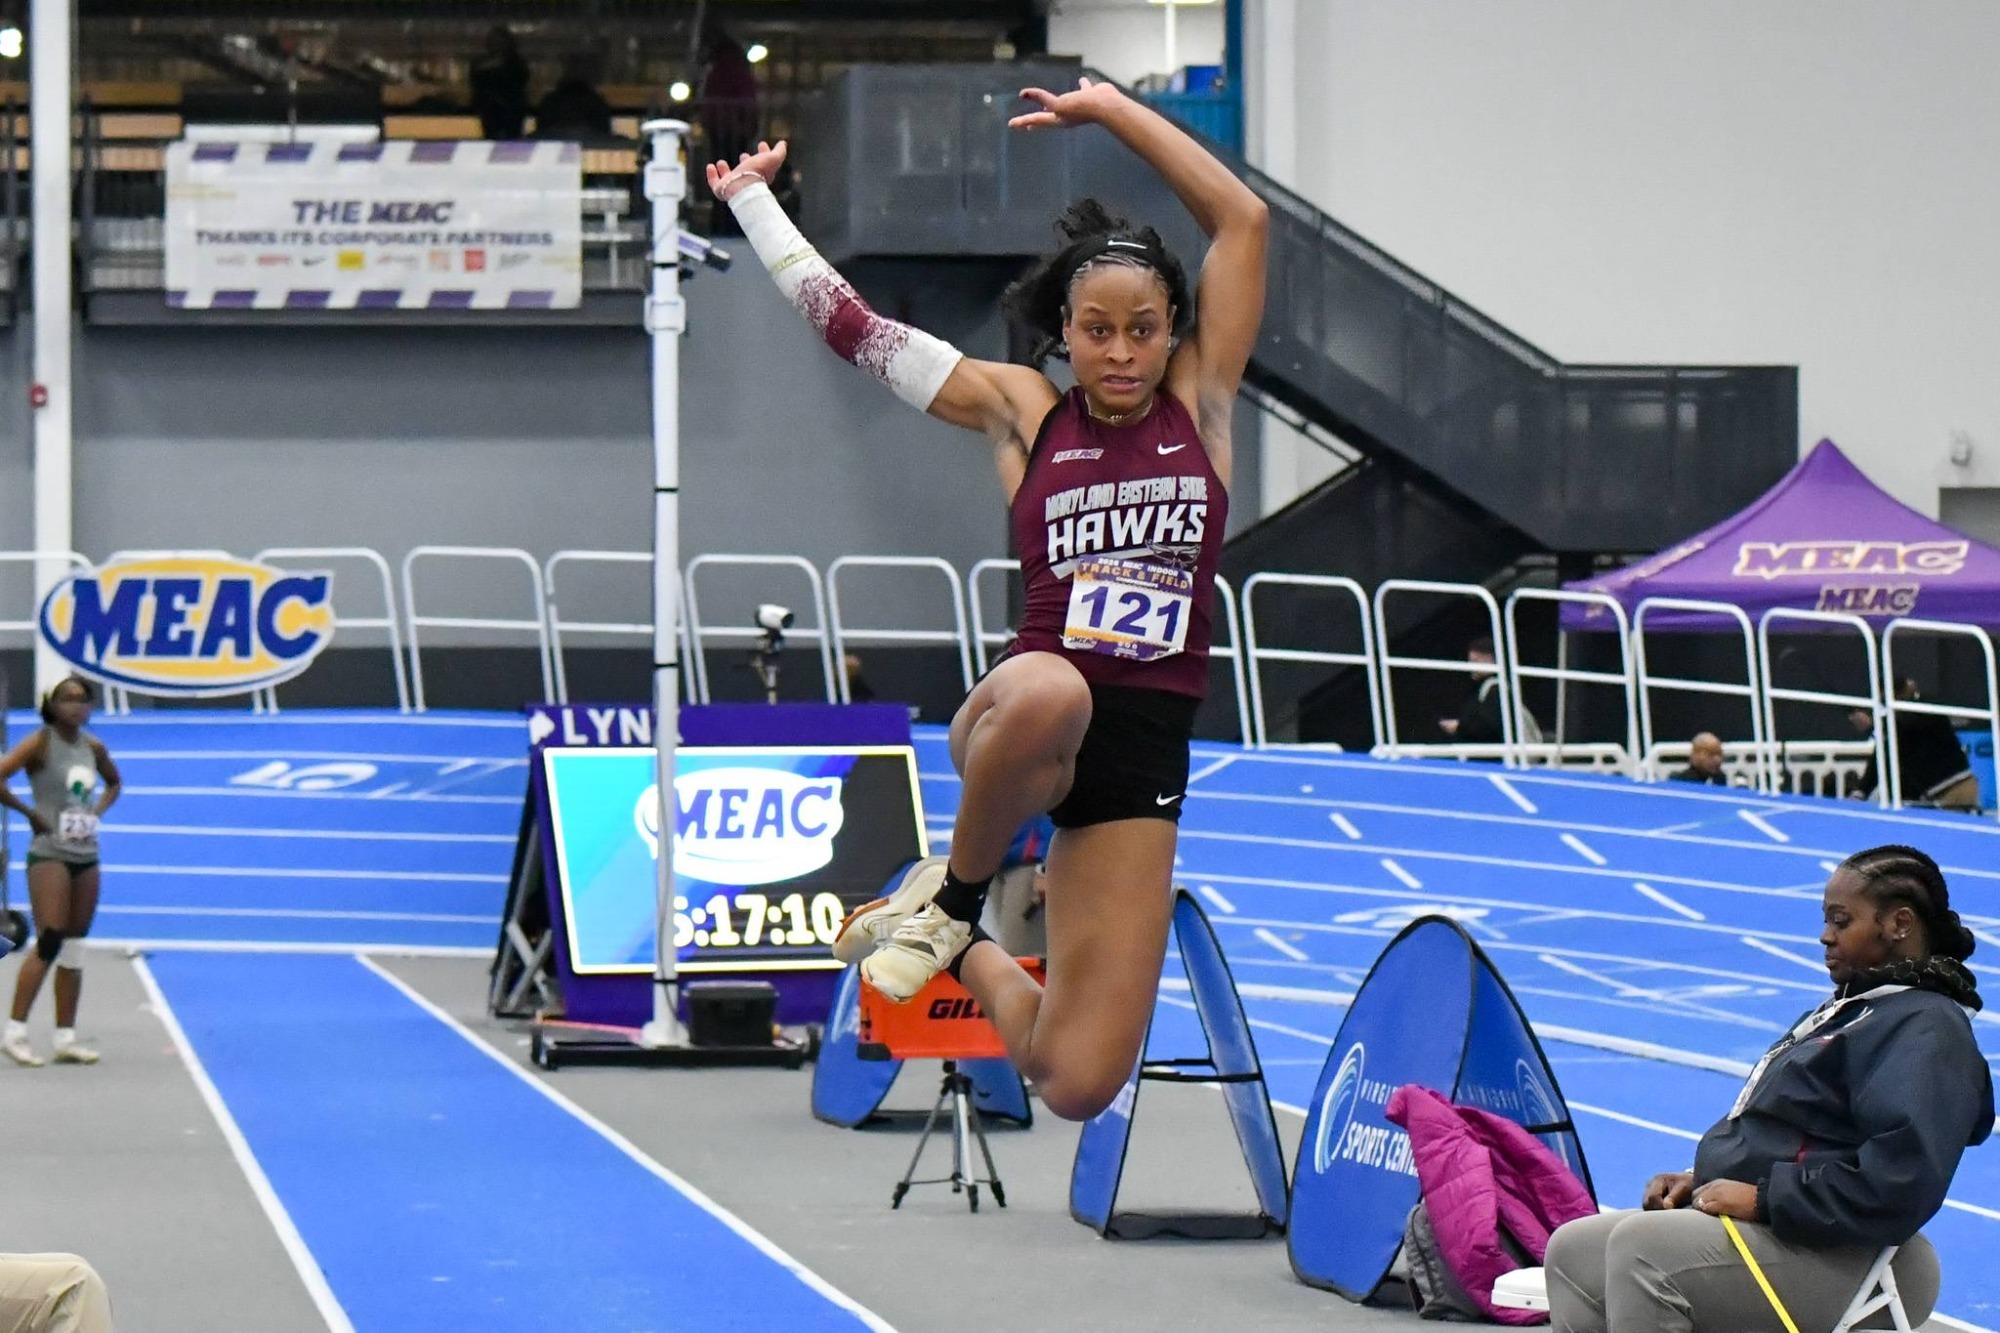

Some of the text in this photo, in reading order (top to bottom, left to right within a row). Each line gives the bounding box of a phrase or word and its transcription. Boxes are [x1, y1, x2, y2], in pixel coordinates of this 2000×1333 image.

[293, 200, 456, 224] THE MEAC
[196, 230, 553, 246] THANKS ITS CORPORATE PARTNERS
[1045, 482, 1115, 523] MARYLAND
[1117, 476, 1177, 506] EASTERN
[1048, 504, 1208, 563] HAWKS
[1081, 562, 1189, 590] TRACK & FIELD
[1147, 565, 1179, 577] INDOOR
[1733, 541, 1969, 579] MEAC
[66, 574, 332, 662] MEAC
[1081, 586, 1182, 643] 121
[1819, 585, 1918, 614] MEAC
[562, 708, 684, 745] LYN
[674, 785, 833, 840] MEAC
[928, 998, 986, 1019] GIL
[1361, 1078, 1398, 1105] VIRGI
[1342, 1121, 1390, 1168] SPORTS
